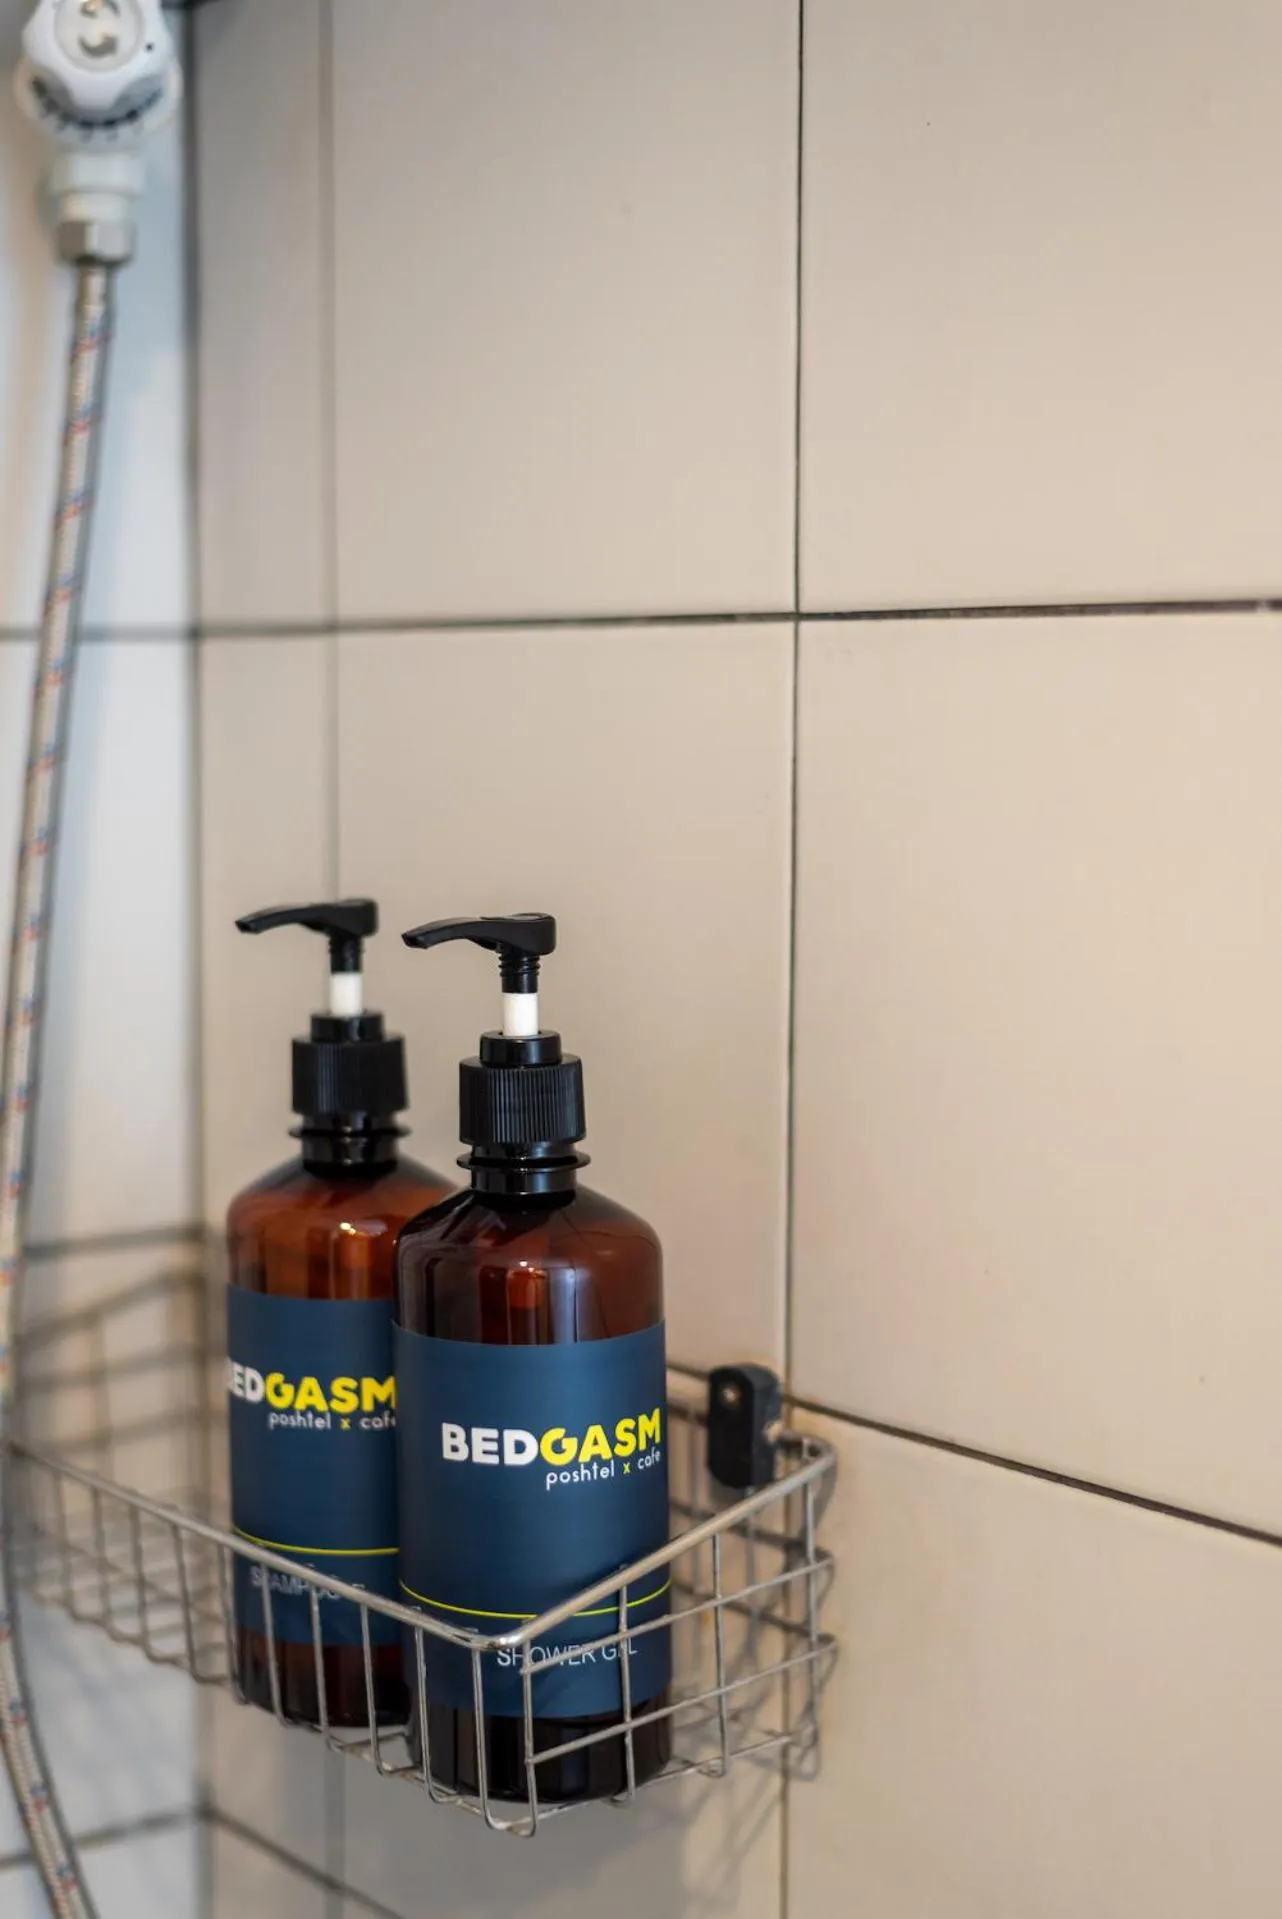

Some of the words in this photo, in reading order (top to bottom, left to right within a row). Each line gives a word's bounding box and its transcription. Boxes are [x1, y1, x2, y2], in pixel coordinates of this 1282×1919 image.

[268, 1411, 332, 1430] poshtel
[340, 1418, 351, 1430] x
[441, 1407, 662, 1466] BEDGASM
[546, 1460, 615, 1491] poshtel
[622, 1462, 632, 1475] x
[637, 1446, 662, 1470] cafe
[602, 1635, 637, 1661] GL
